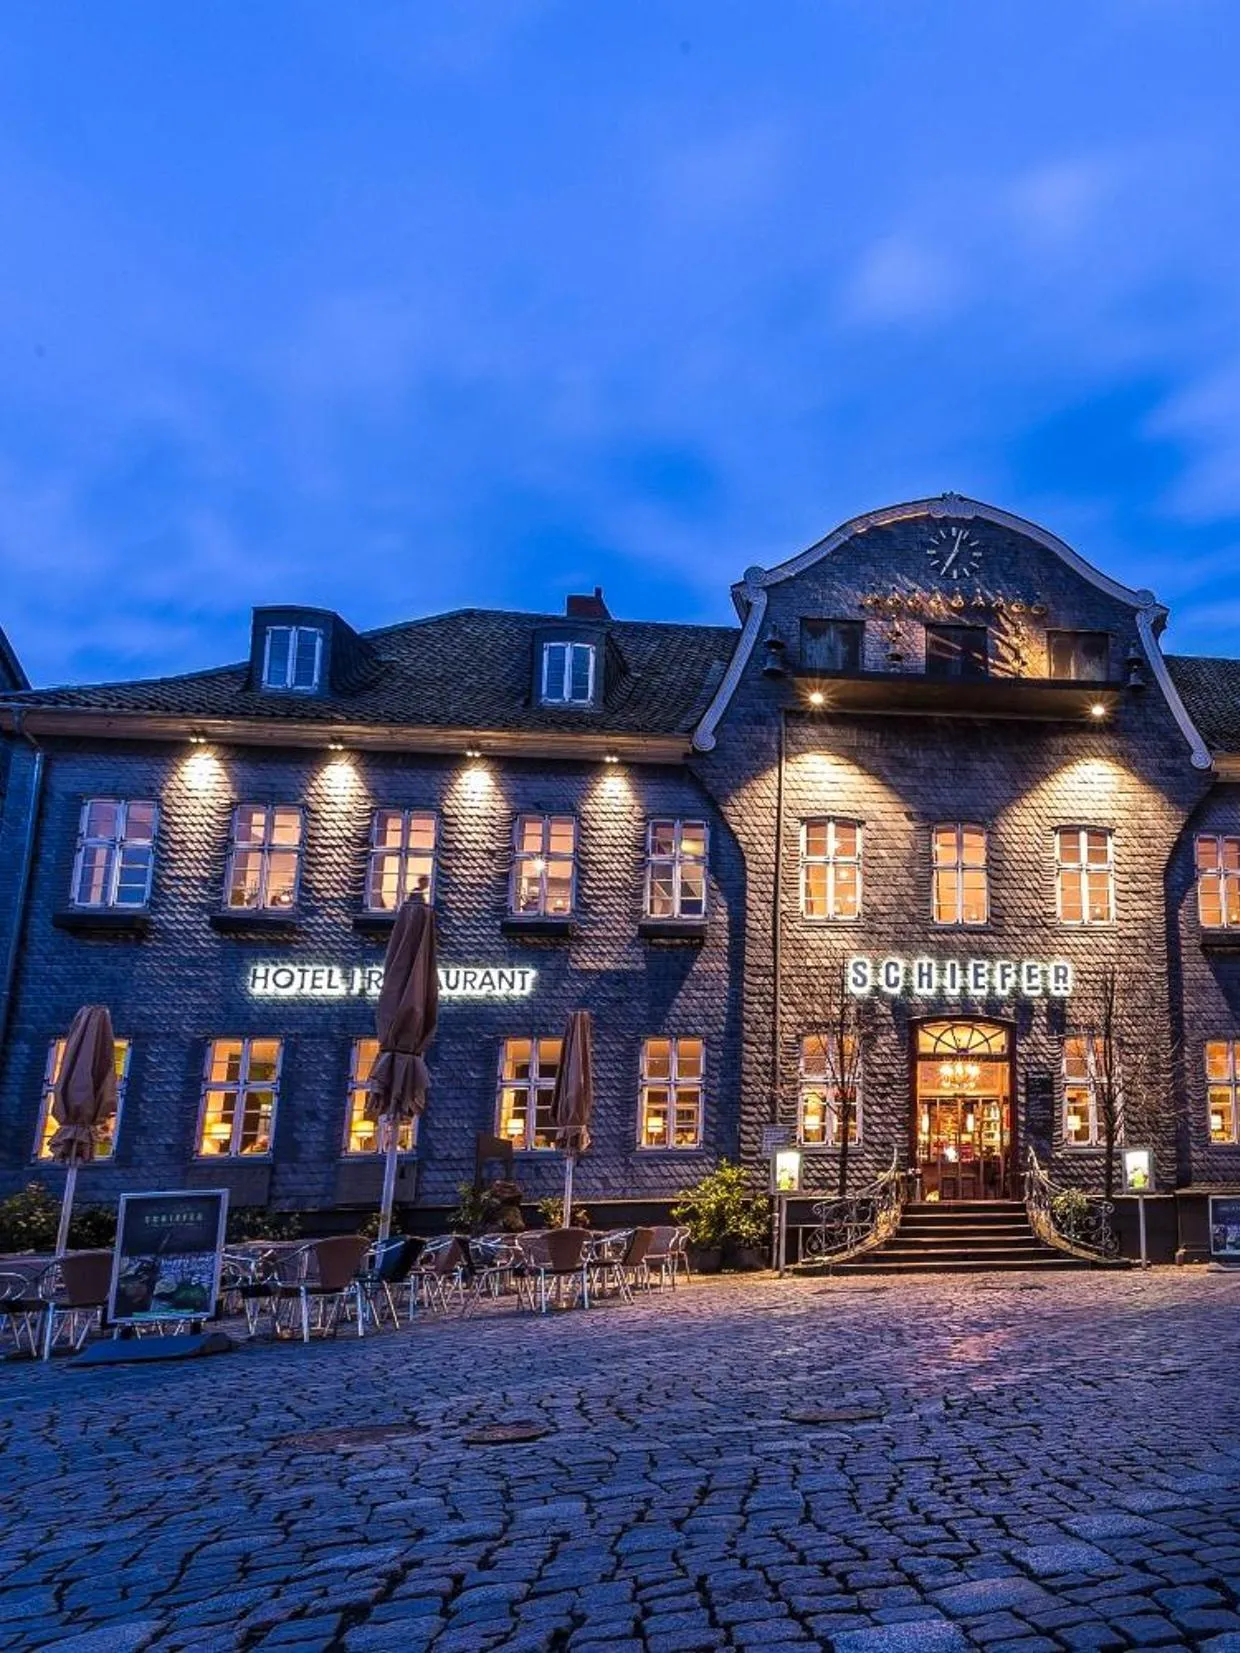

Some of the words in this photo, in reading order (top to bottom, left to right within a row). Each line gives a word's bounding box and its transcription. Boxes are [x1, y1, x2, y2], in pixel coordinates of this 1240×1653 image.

[250, 967, 340, 990] HOTEL
[367, 969, 531, 992] RURANT
[851, 960, 1070, 991] SCHIEFER
